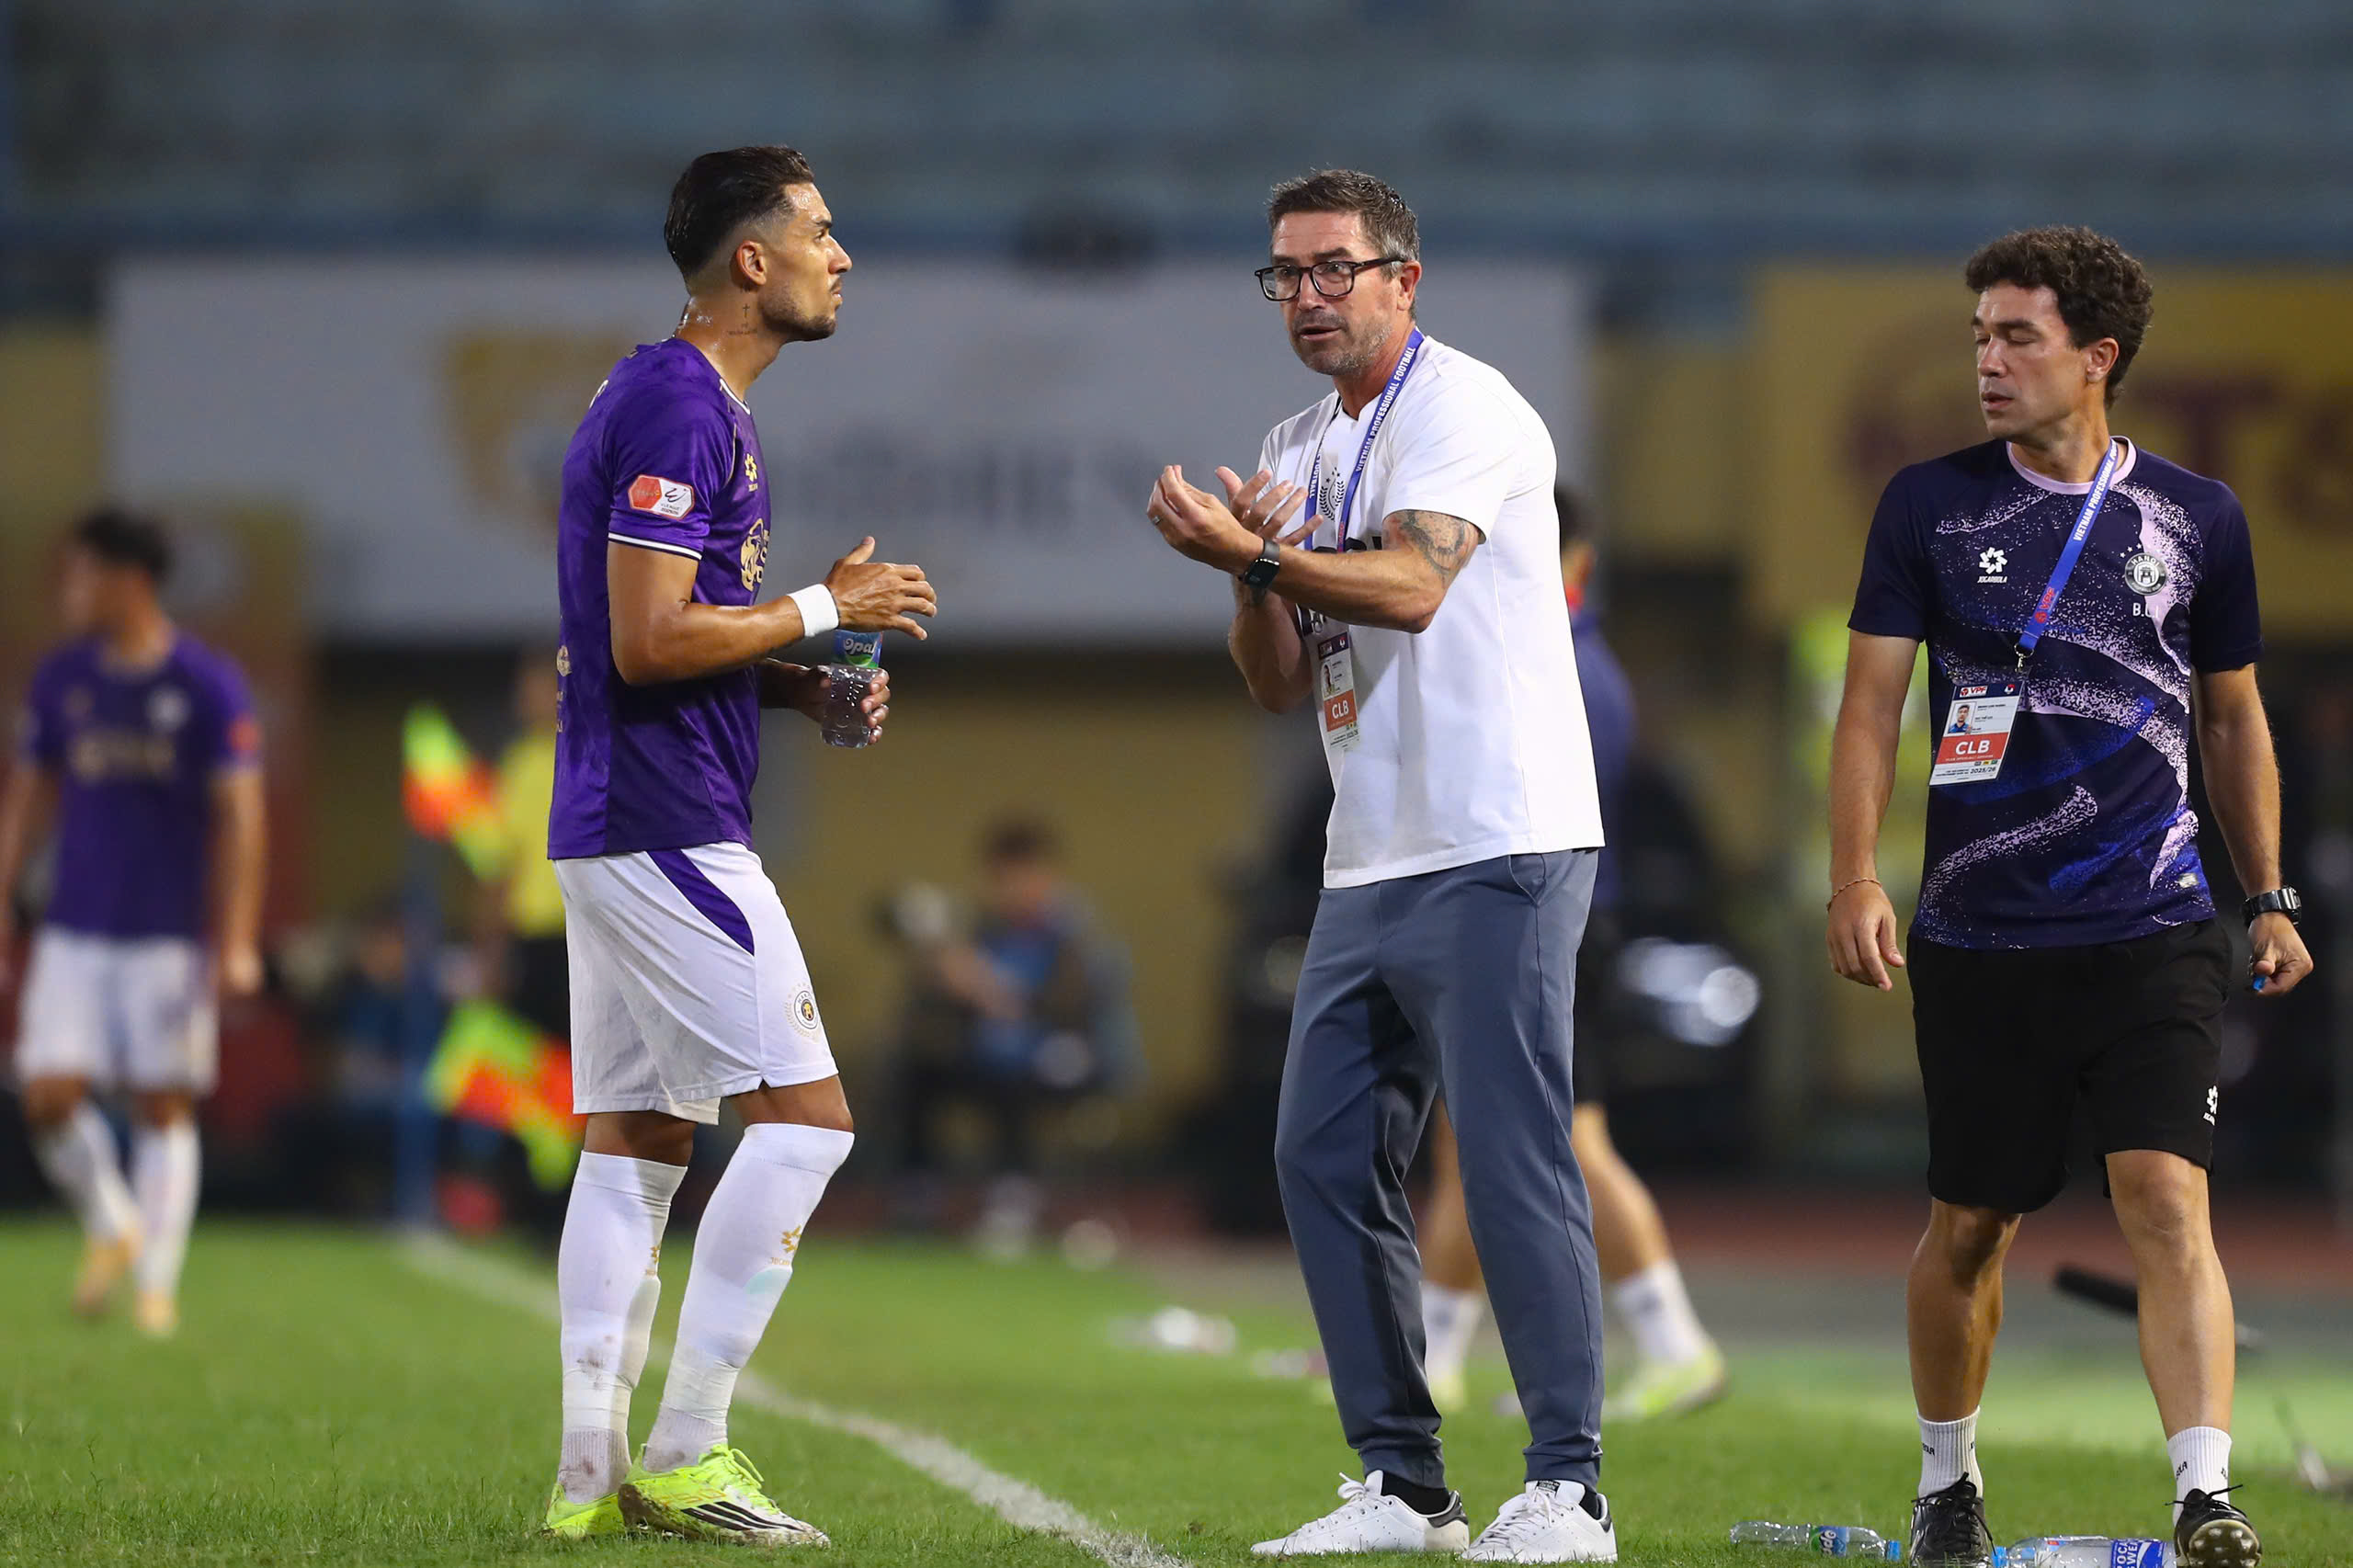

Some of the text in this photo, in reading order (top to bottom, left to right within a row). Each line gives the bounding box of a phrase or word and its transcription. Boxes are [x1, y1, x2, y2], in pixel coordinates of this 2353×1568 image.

[1355, 347, 1416, 472] VIETNAM PROFESSIONAL FOOTBALL
[2073, 459, 2115, 542] VIETNAM PROFESSIONAL
[2131, 555, 2160, 567] HANOI
[843, 638, 878, 655] Opal
[1332, 700, 1349, 720] CLB
[1955, 740, 1991, 756] CLB
[1820, 1529, 1837, 1556] Opa
